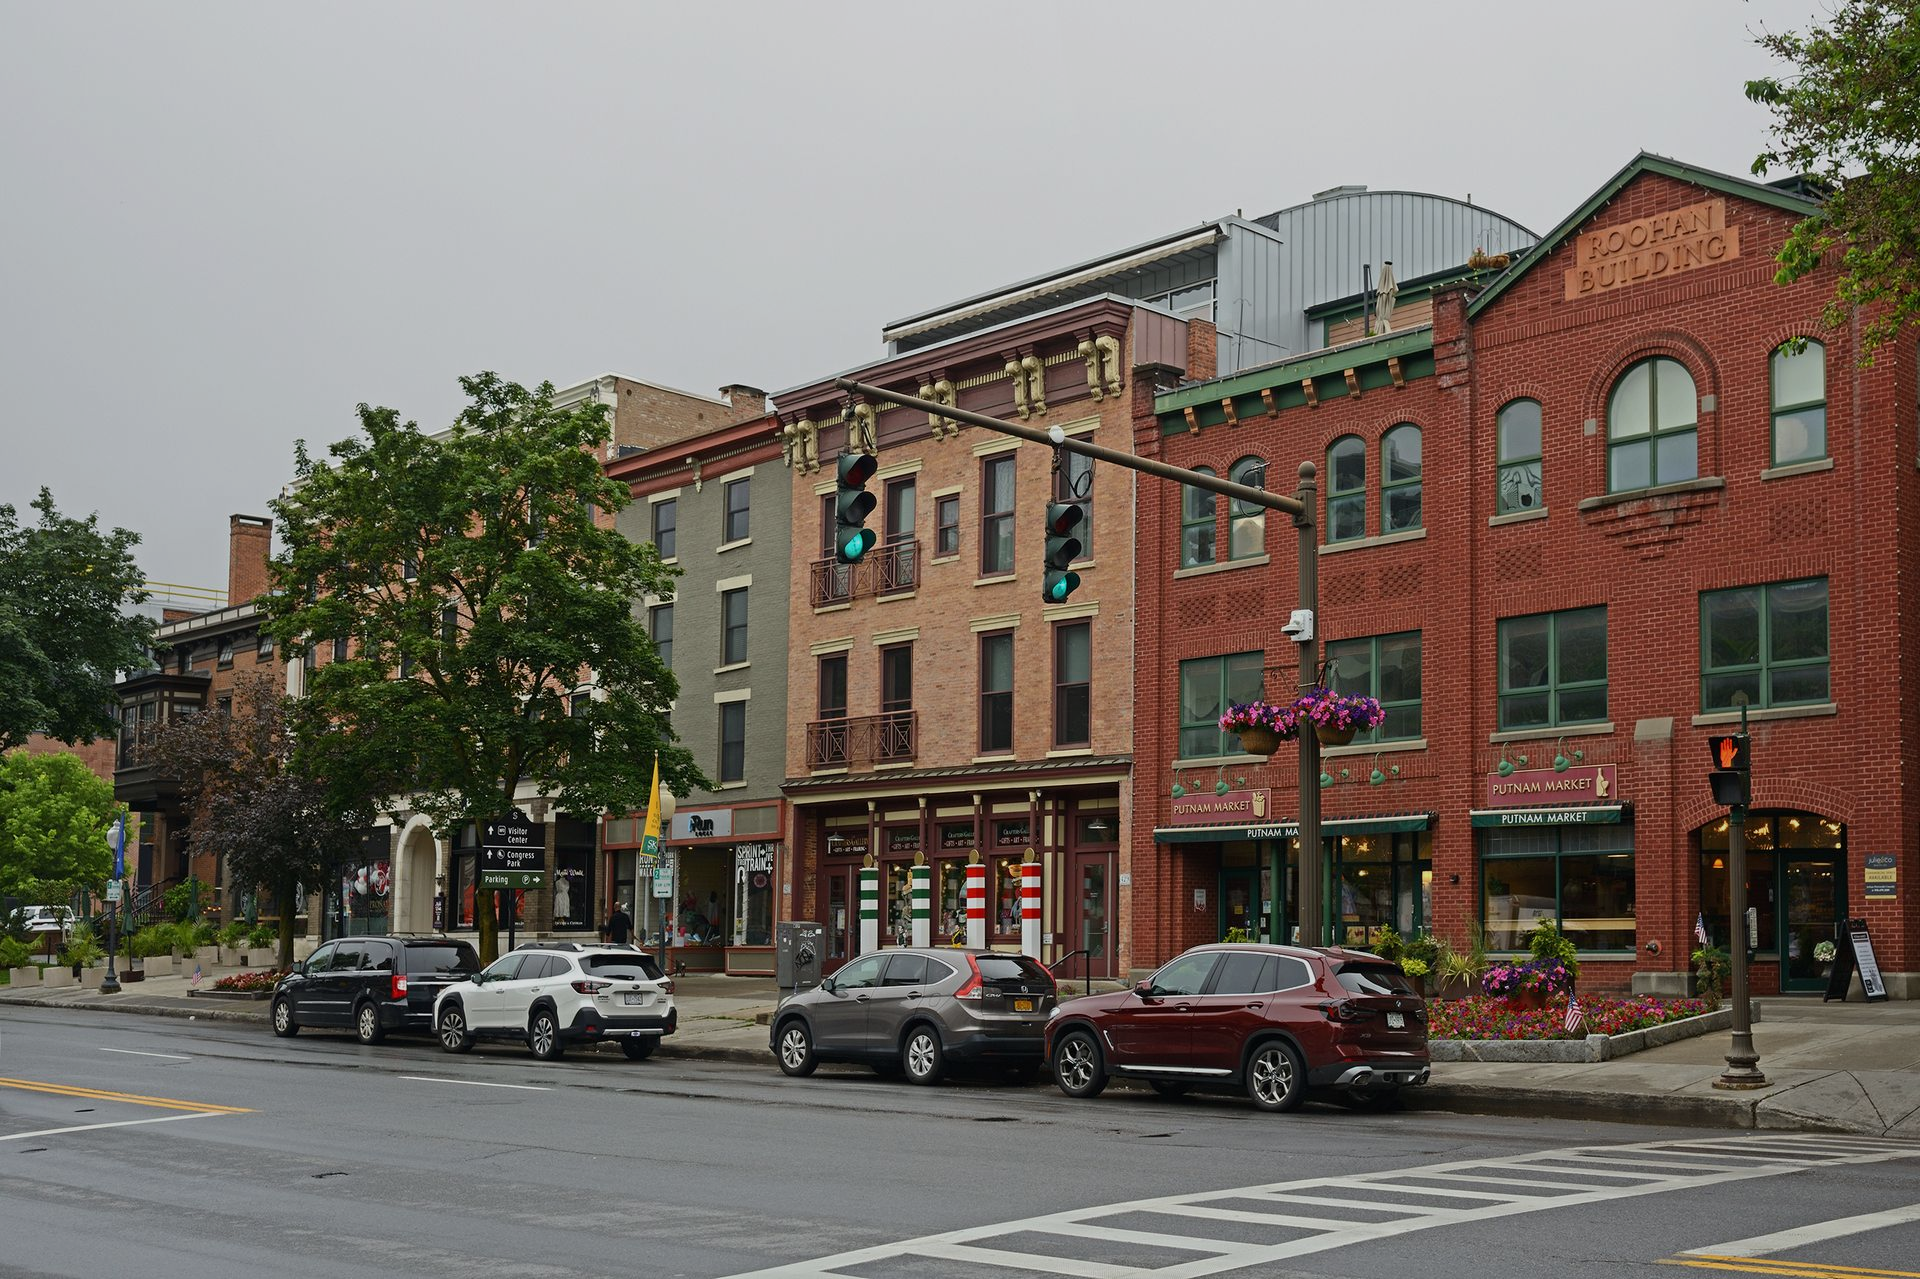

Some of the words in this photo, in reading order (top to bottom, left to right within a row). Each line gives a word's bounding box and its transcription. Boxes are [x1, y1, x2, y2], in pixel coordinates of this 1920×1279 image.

[1588, 206, 1712, 259] ROOHAN
[1579, 234, 1726, 293] BUILDING
[1493, 782, 1541, 795] PUTNAM
[1545, 778, 1592, 791] MARKET
[1173, 804, 1211, 815] PUTNAM
[1214, 801, 1250, 812] MARKET
[1502, 813, 1543, 824] PUTNAM
[1547, 812, 1587, 823] MARKET
[507, 827, 528, 835] Visitor
[1247, 829, 1282, 838] PUTNAM
[507, 836, 528, 844] Center
[507, 851, 535, 860] Congress
[738, 844, 761, 858] SPRINT
[745, 858, 768, 871] TRAIN
[485, 876, 509, 885] Parking
